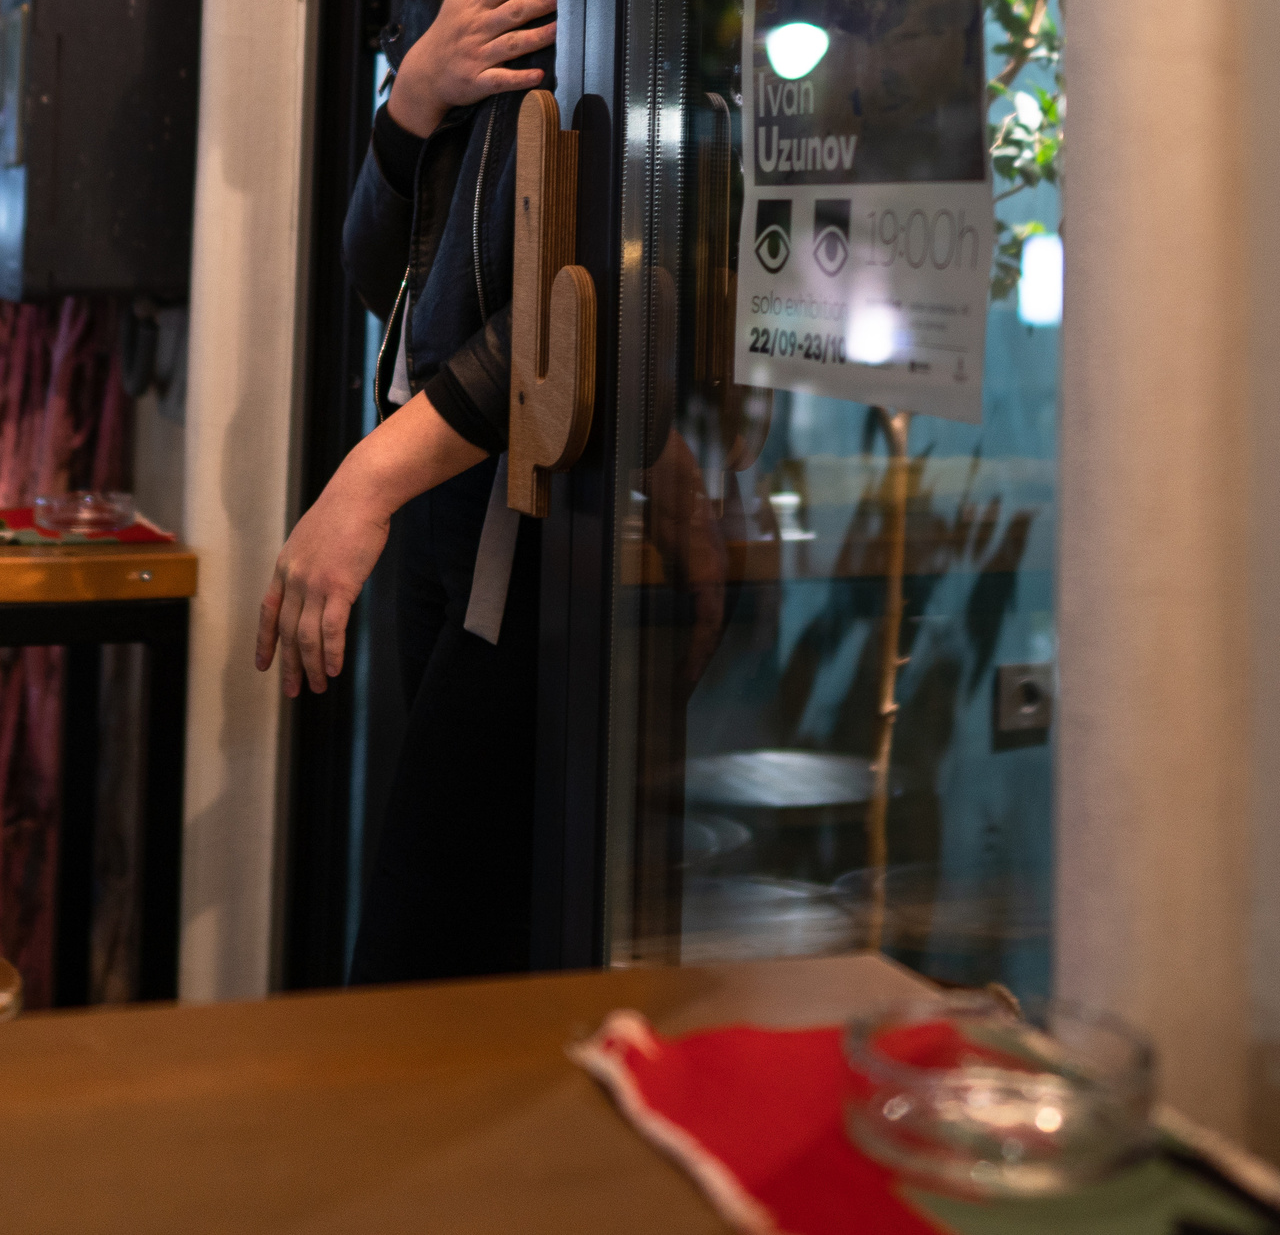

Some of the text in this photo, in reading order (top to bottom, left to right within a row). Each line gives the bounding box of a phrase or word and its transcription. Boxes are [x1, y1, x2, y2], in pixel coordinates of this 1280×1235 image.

[758, 72, 815, 118] Ivan
[757, 125, 858, 173] Uzunov
[866, 208, 980, 270] 19:00h
[751, 290, 782, 316] solo
